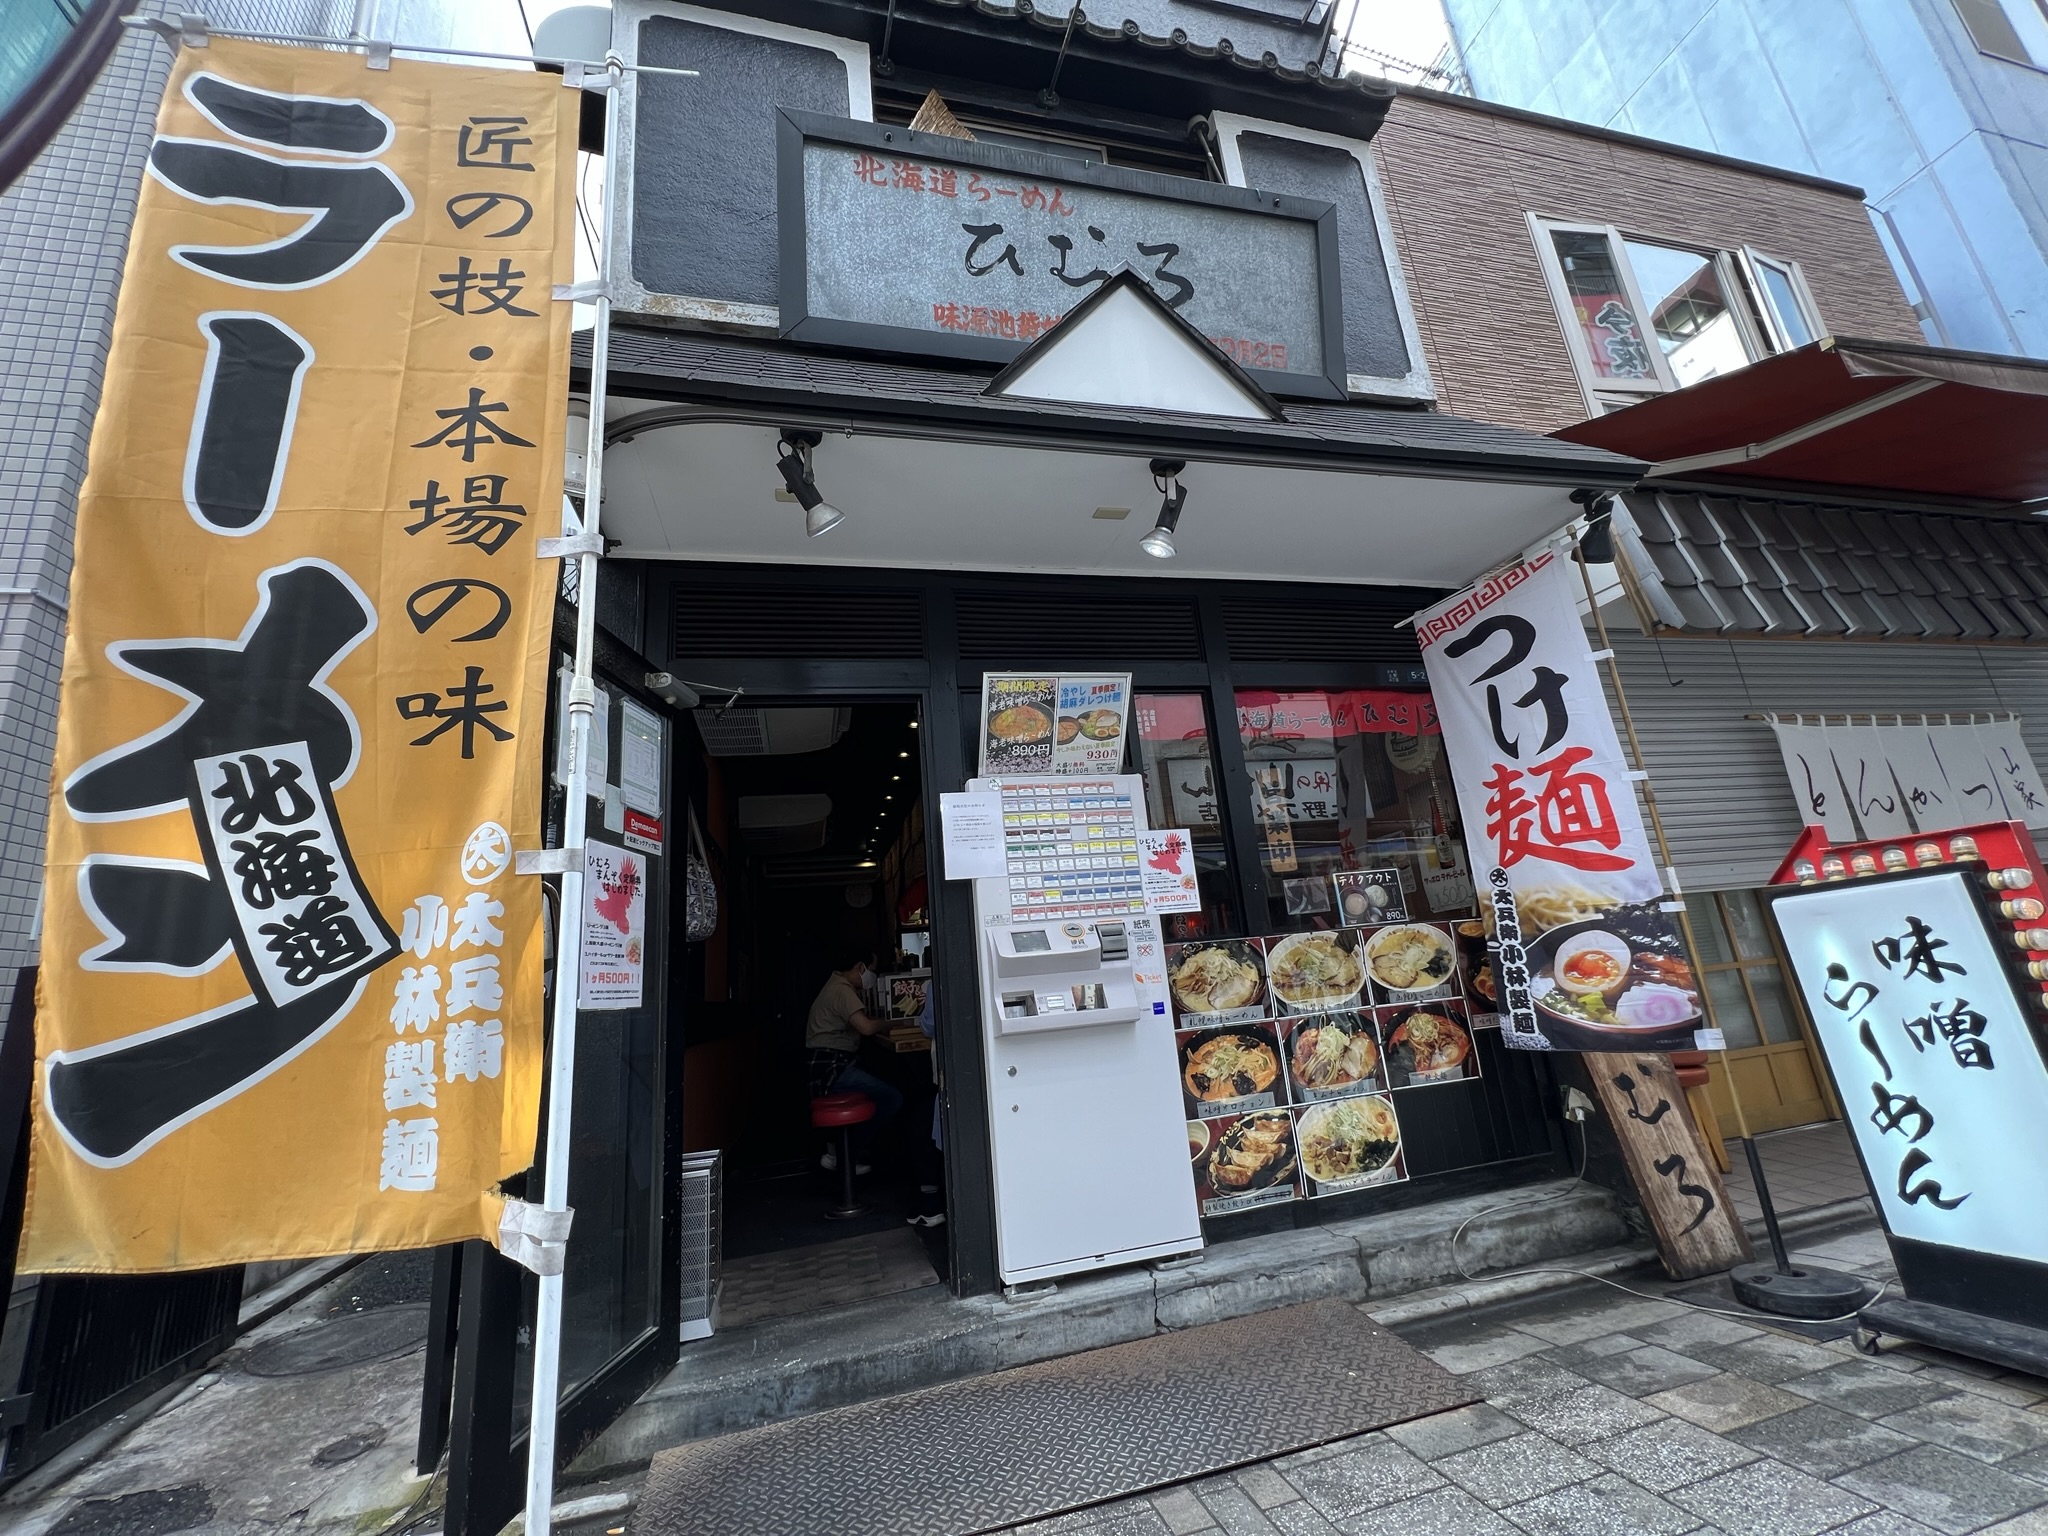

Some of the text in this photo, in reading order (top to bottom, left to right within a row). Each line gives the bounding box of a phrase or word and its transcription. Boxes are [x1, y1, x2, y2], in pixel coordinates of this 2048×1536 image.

[853, 152, 1075, 218] 北海道らーめん
[961, 222, 1194, 308] ひむろ
[396, 115, 541, 759] 匠の技・本場の味
[44, 70, 414, 1169] ラーメン
[1059, 691, 1121, 710] 胡麻ダレつけ麺
[1060, 687, 1087, 698] 冷やし
[1011, 743, 1050, 757] 890円
[1086, 749, 1118, 760] 930円
[1444, 613, 1635, 872] つけ麺
[1796, 752, 1993, 817] とんかつ
[211, 753, 374, 987] 北海道
[588, 855, 610, 870] ひむろ
[1338, 872, 1392, 887] テイクアウト
[1132, 919, 1151, 930] 紙幣
[1493, 888, 1538, 1035] 太兵衛小林製麺
[443, 891, 505, 1083] 太兵衛
[1870, 916, 1995, 1071] 味噌
[380, 894, 449, 1192] 小林製麺
[1826, 962, 1974, 1213] らーめん
